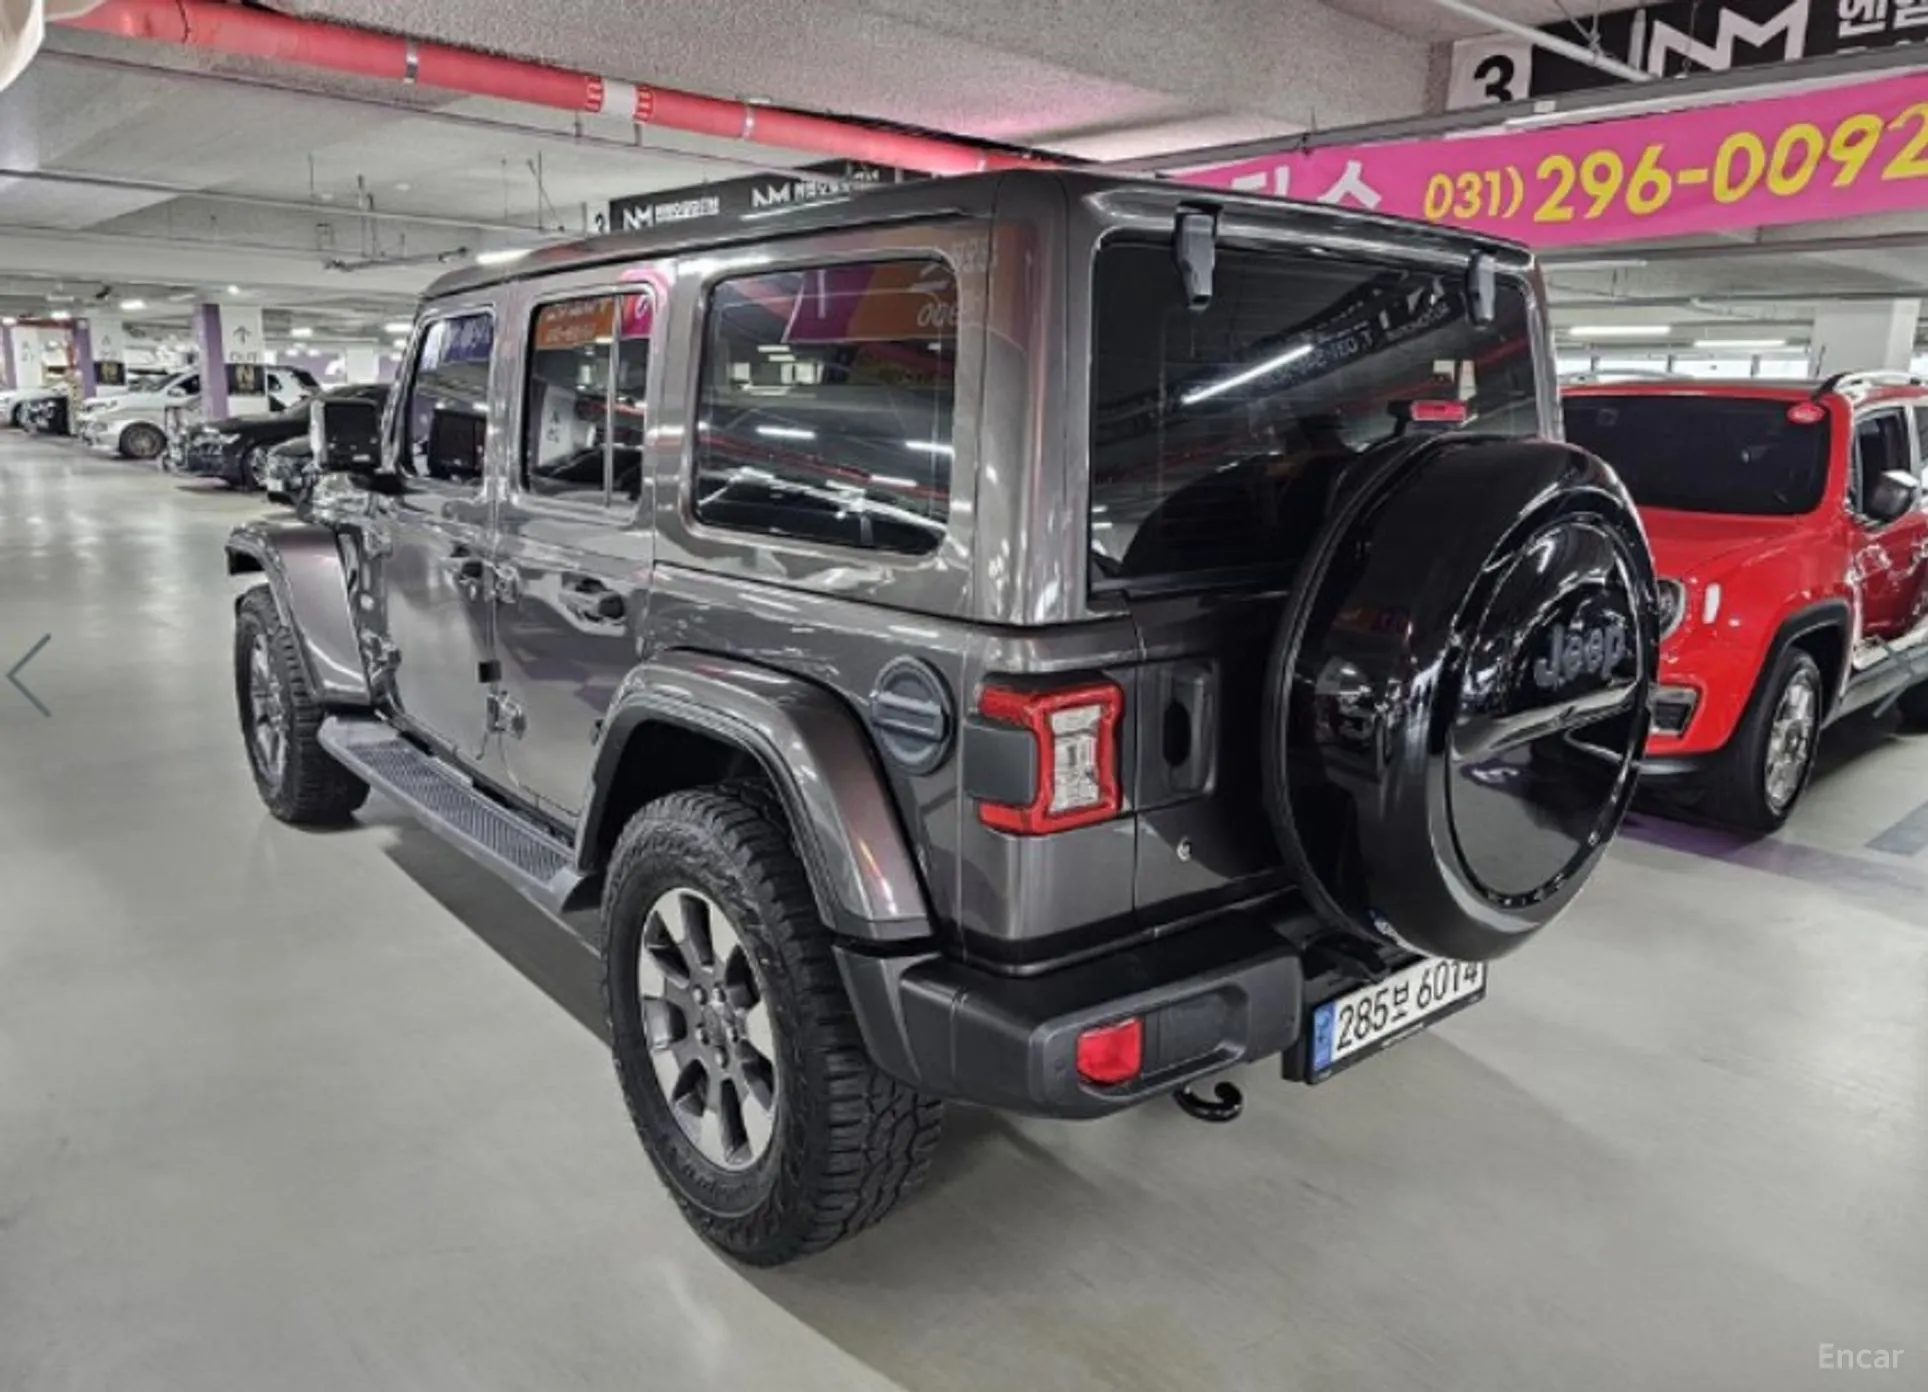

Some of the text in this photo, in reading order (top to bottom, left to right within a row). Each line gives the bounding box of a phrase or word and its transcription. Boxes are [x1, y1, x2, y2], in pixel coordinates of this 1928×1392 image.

[1473, 54, 1516, 101] 3
[1424, 165, 1524, 223] 031)
[1533, 102, 1928, 223] 296-0092
[1533, 623, 1625, 690] Jeep
[1417, 960, 1478, 1010] 6014
